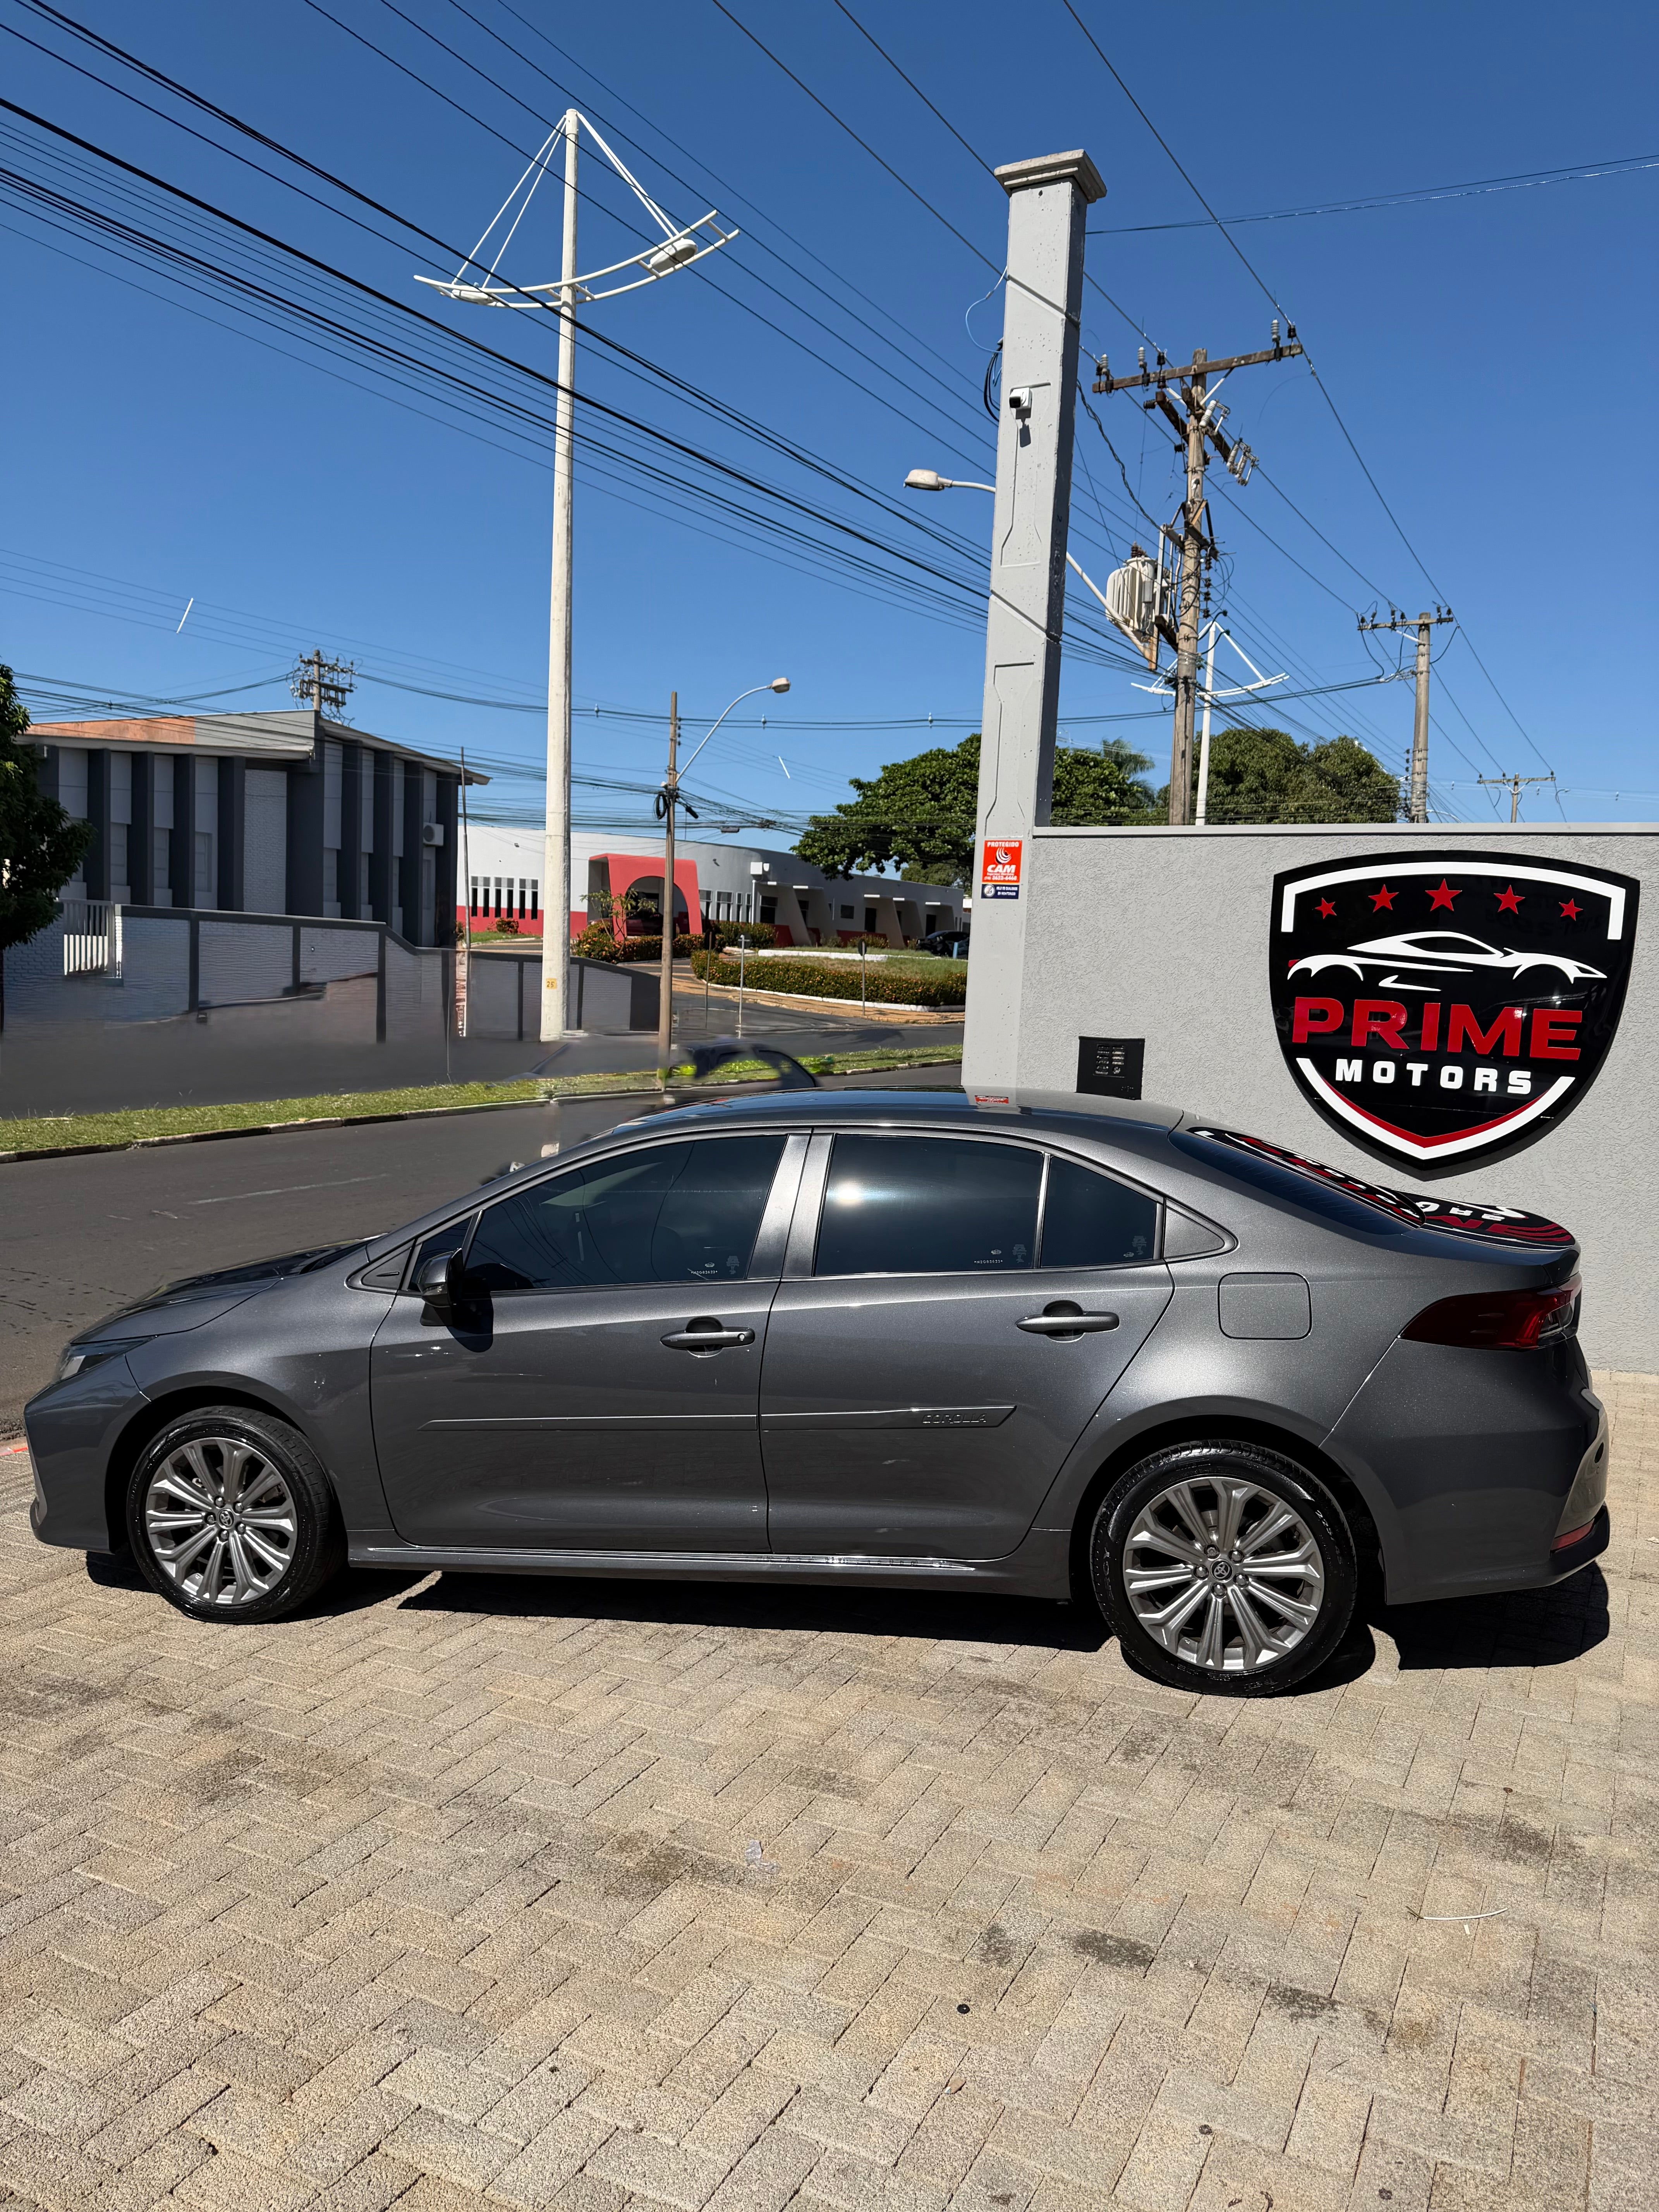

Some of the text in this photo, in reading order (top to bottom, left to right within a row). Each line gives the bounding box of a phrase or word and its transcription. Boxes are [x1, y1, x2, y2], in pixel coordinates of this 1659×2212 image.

[987, 864, 1016, 873] CAM
[1292, 996, 1583, 1060] PRIME
[1336, 1058, 1532, 1094] MOTORS
[922, 1413, 987, 1424] COROLLA
